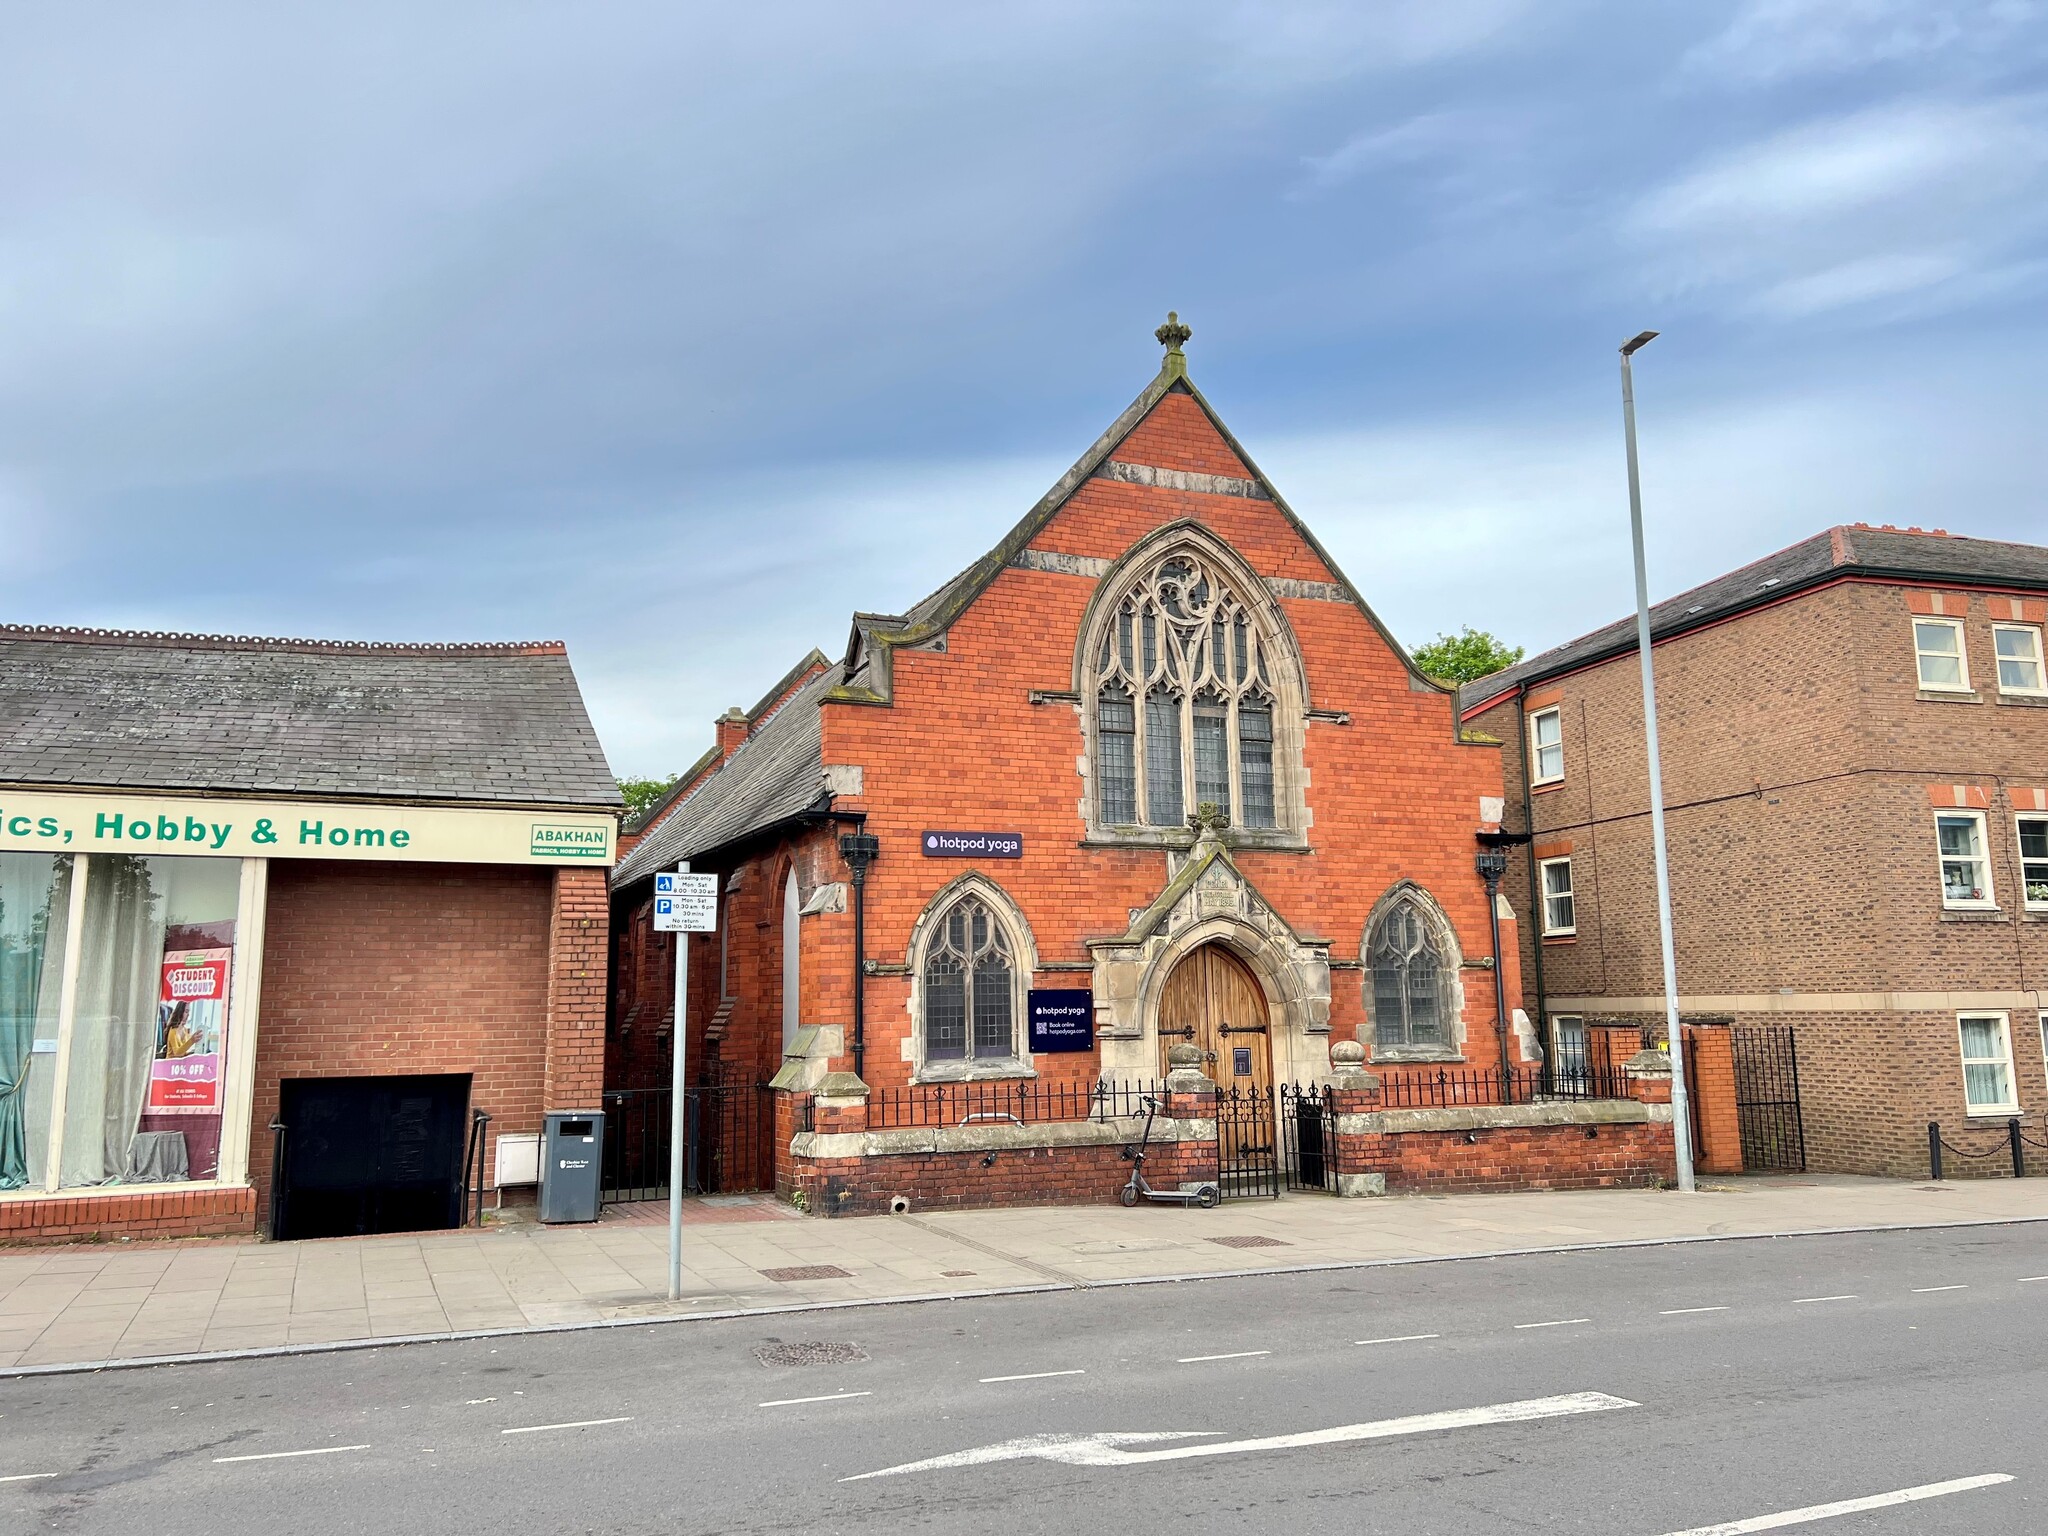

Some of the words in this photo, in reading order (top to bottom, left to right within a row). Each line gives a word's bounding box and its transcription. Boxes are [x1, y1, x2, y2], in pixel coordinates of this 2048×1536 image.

[95, 812, 232, 849] Hobby
[251, 818, 278, 844] &
[299, 820, 410, 848] Home
[536, 830, 603, 842] ABAKHAN
[940, 836, 984, 852] hotpod
[988, 840, 1017, 852] yoga
[660, 901, 669, 912] P
[175, 970, 213, 981] STUDENT
[174, 982, 213, 994] DISCOUNT
[1043, 1007, 1067, 1016] hotpod
[171, 1064, 186, 1075] 10%
[189, 1064, 205, 1075] OFF
